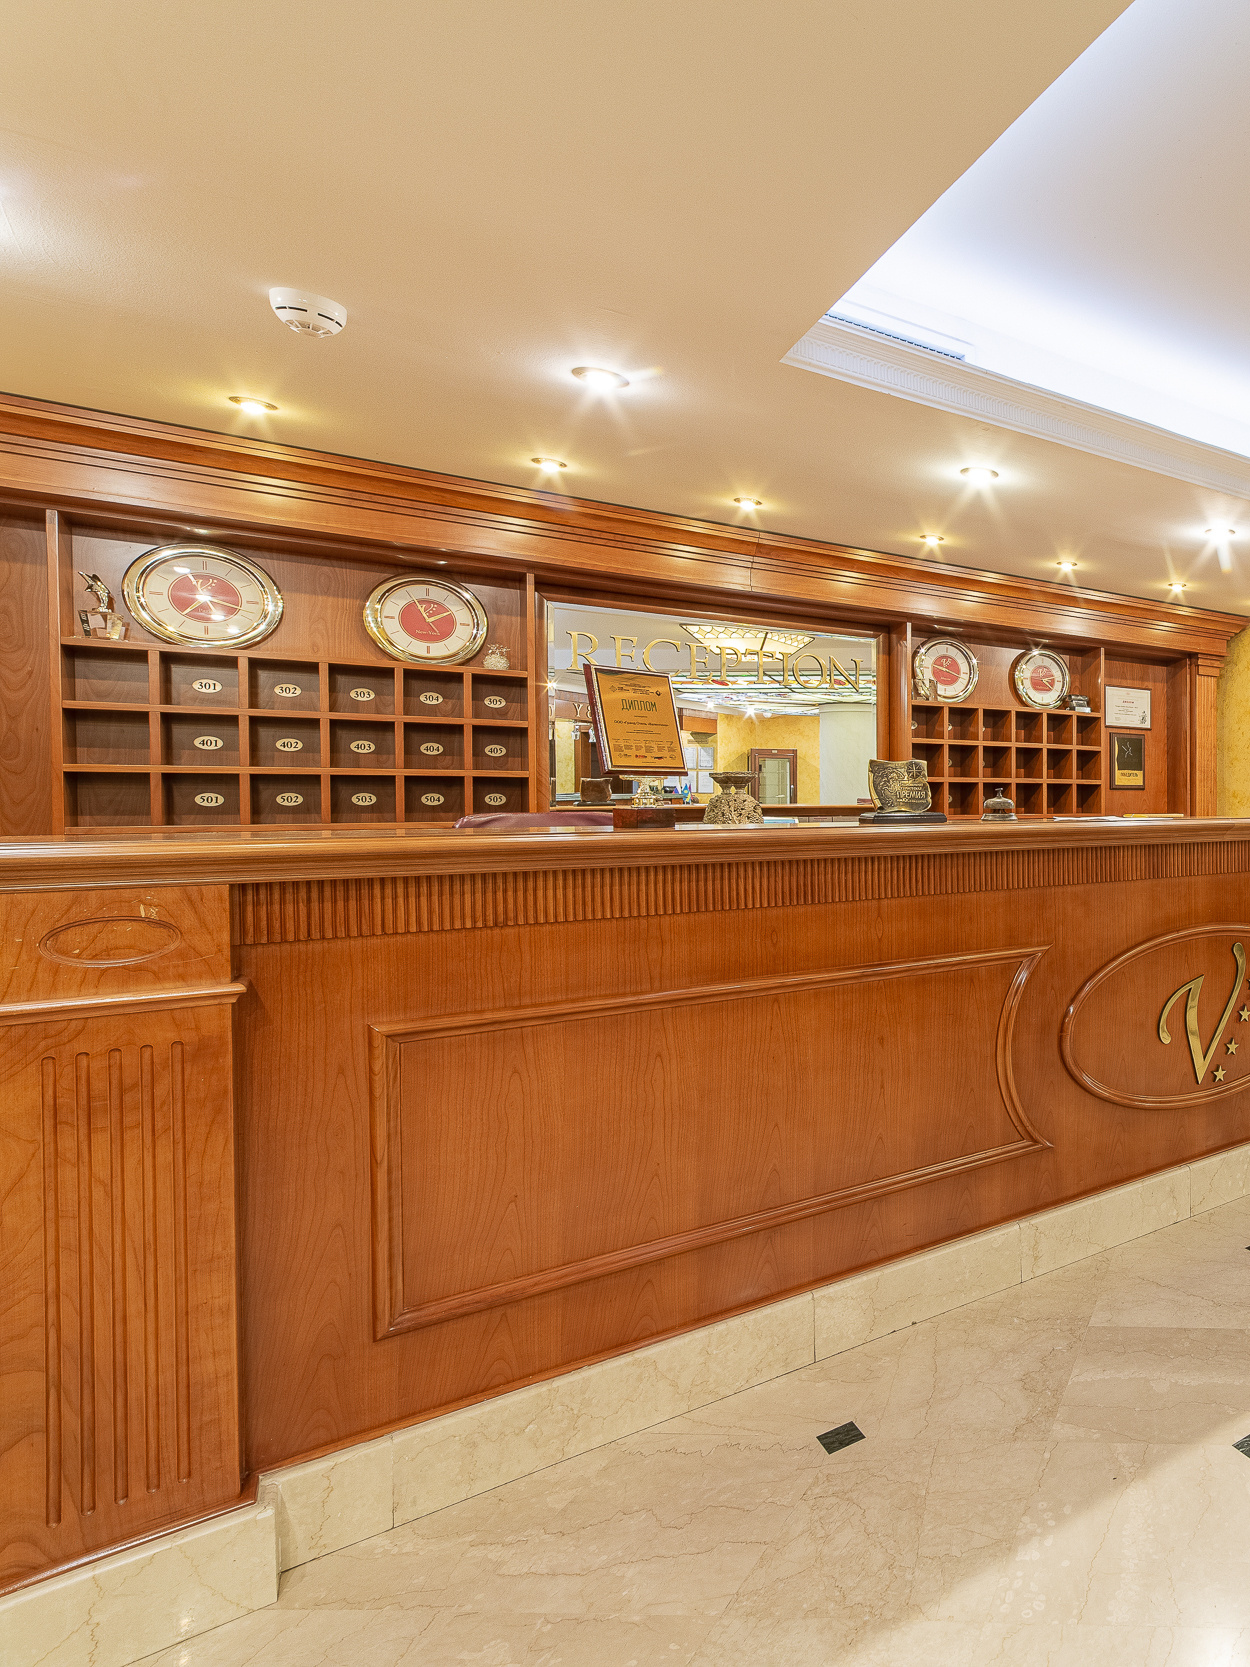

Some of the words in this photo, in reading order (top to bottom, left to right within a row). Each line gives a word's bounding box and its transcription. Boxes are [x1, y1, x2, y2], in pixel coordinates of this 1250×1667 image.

[565, 630, 864, 693] RECEPTION
[197, 681, 217, 691] 301
[278, 686, 297, 695] 302
[354, 690, 371, 698] 303
[423, 694, 439, 702] 304
[487, 698, 503, 706] 305
[621, 699, 657, 712] ДИПЛОМ
[198, 739, 219, 747] 401
[280, 741, 299, 749] 402
[353, 743, 372, 751] 403
[423, 745, 440, 753] 404
[896, 790, 926, 799] ПРЕМИЯ
[199, 795, 220, 804] 501
[280, 795, 299, 804] 502
[355, 795, 373, 803] 503
[424, 795, 441, 803] 504
[488, 795, 503, 803] 505
[1159, 942, 1246, 1085] V
